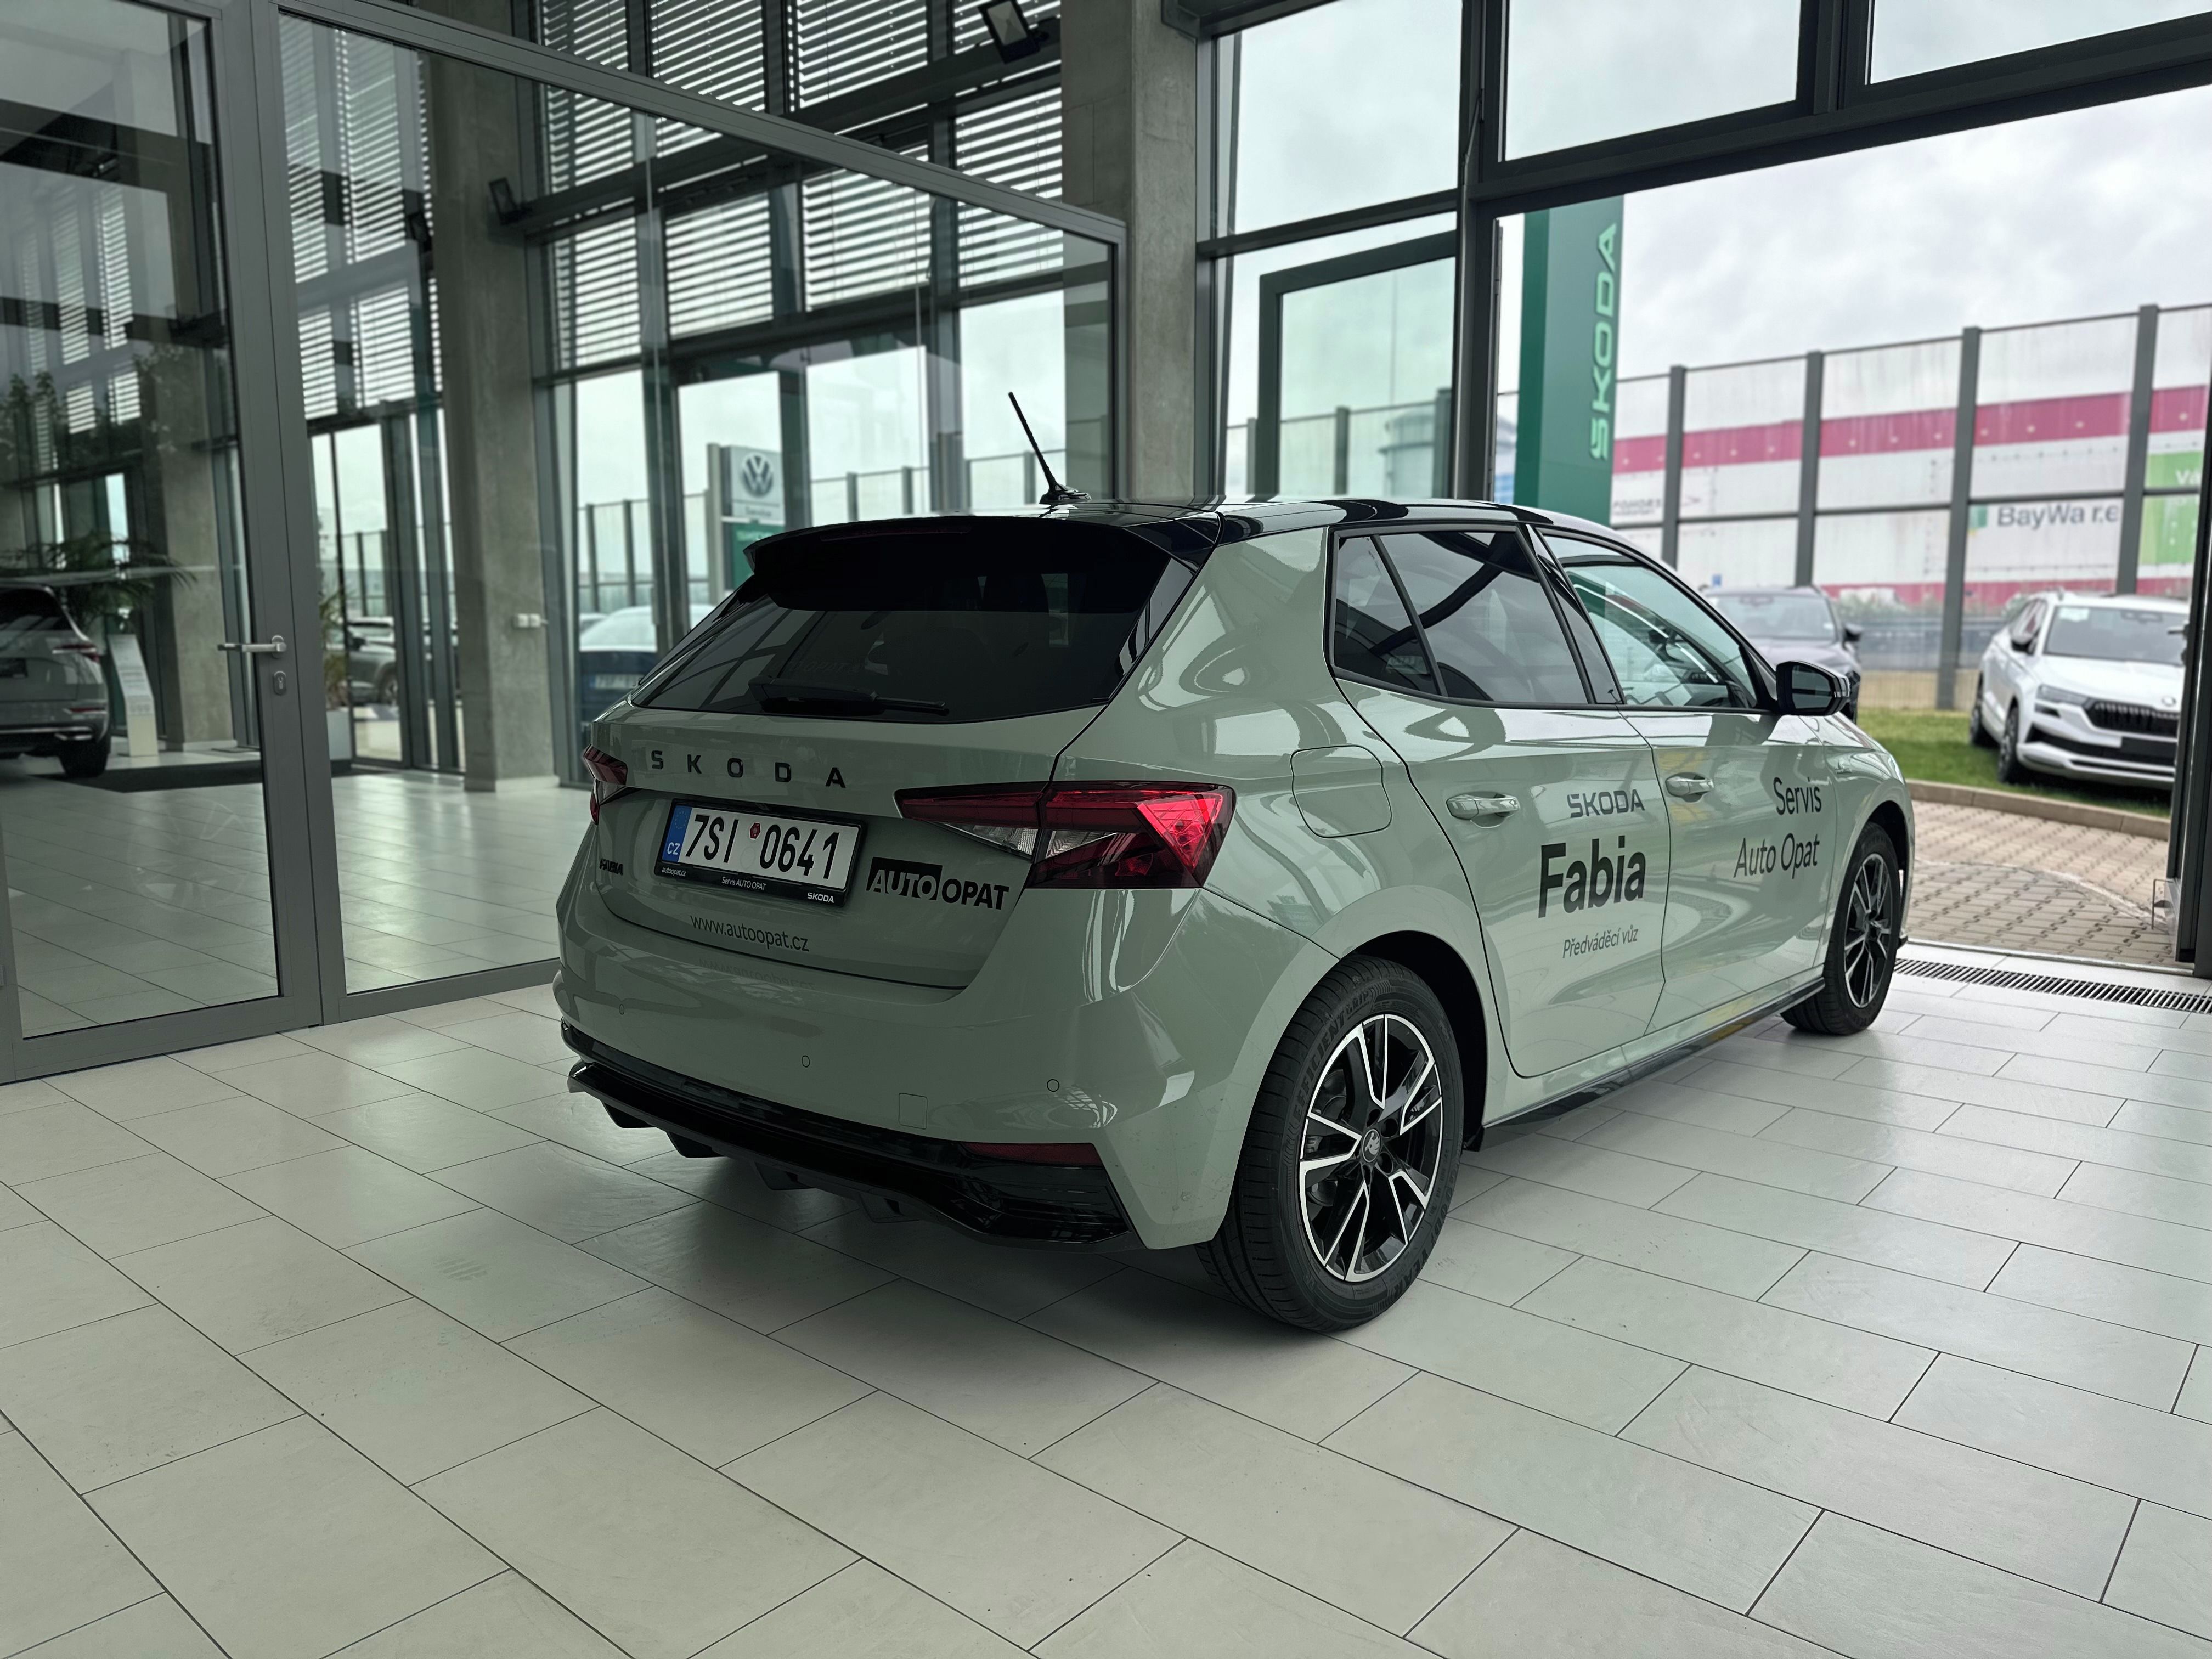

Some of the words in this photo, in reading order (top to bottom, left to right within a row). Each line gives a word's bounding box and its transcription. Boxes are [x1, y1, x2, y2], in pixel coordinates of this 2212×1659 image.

[1997, 503, 2085, 531] BayWa
[1773, 776, 1822, 815] Servis
[667, 842, 680, 855] CZ
[685, 814, 739, 863] 7SI
[759, 824, 839, 879] 0641
[1733, 837, 1776, 878] Auto
[1780, 832, 1820, 879] Opat
[599, 858, 623, 876] FABIA
[662, 867, 686, 877] autoopat.cz
[721, 876, 736, 885] Servis
[736, 879, 752, 889] AUTO
[752, 881, 766, 890] OPAT
[1538, 835, 1646, 918] Fabia
[868, 869, 937, 900] AUTO
[941, 878, 1009, 910] OPAT
[691, 915, 810, 953] www.autoopat.cz
[1562, 927, 1621, 958] Předváděcí
[1622, 924, 1639, 944] vůz
